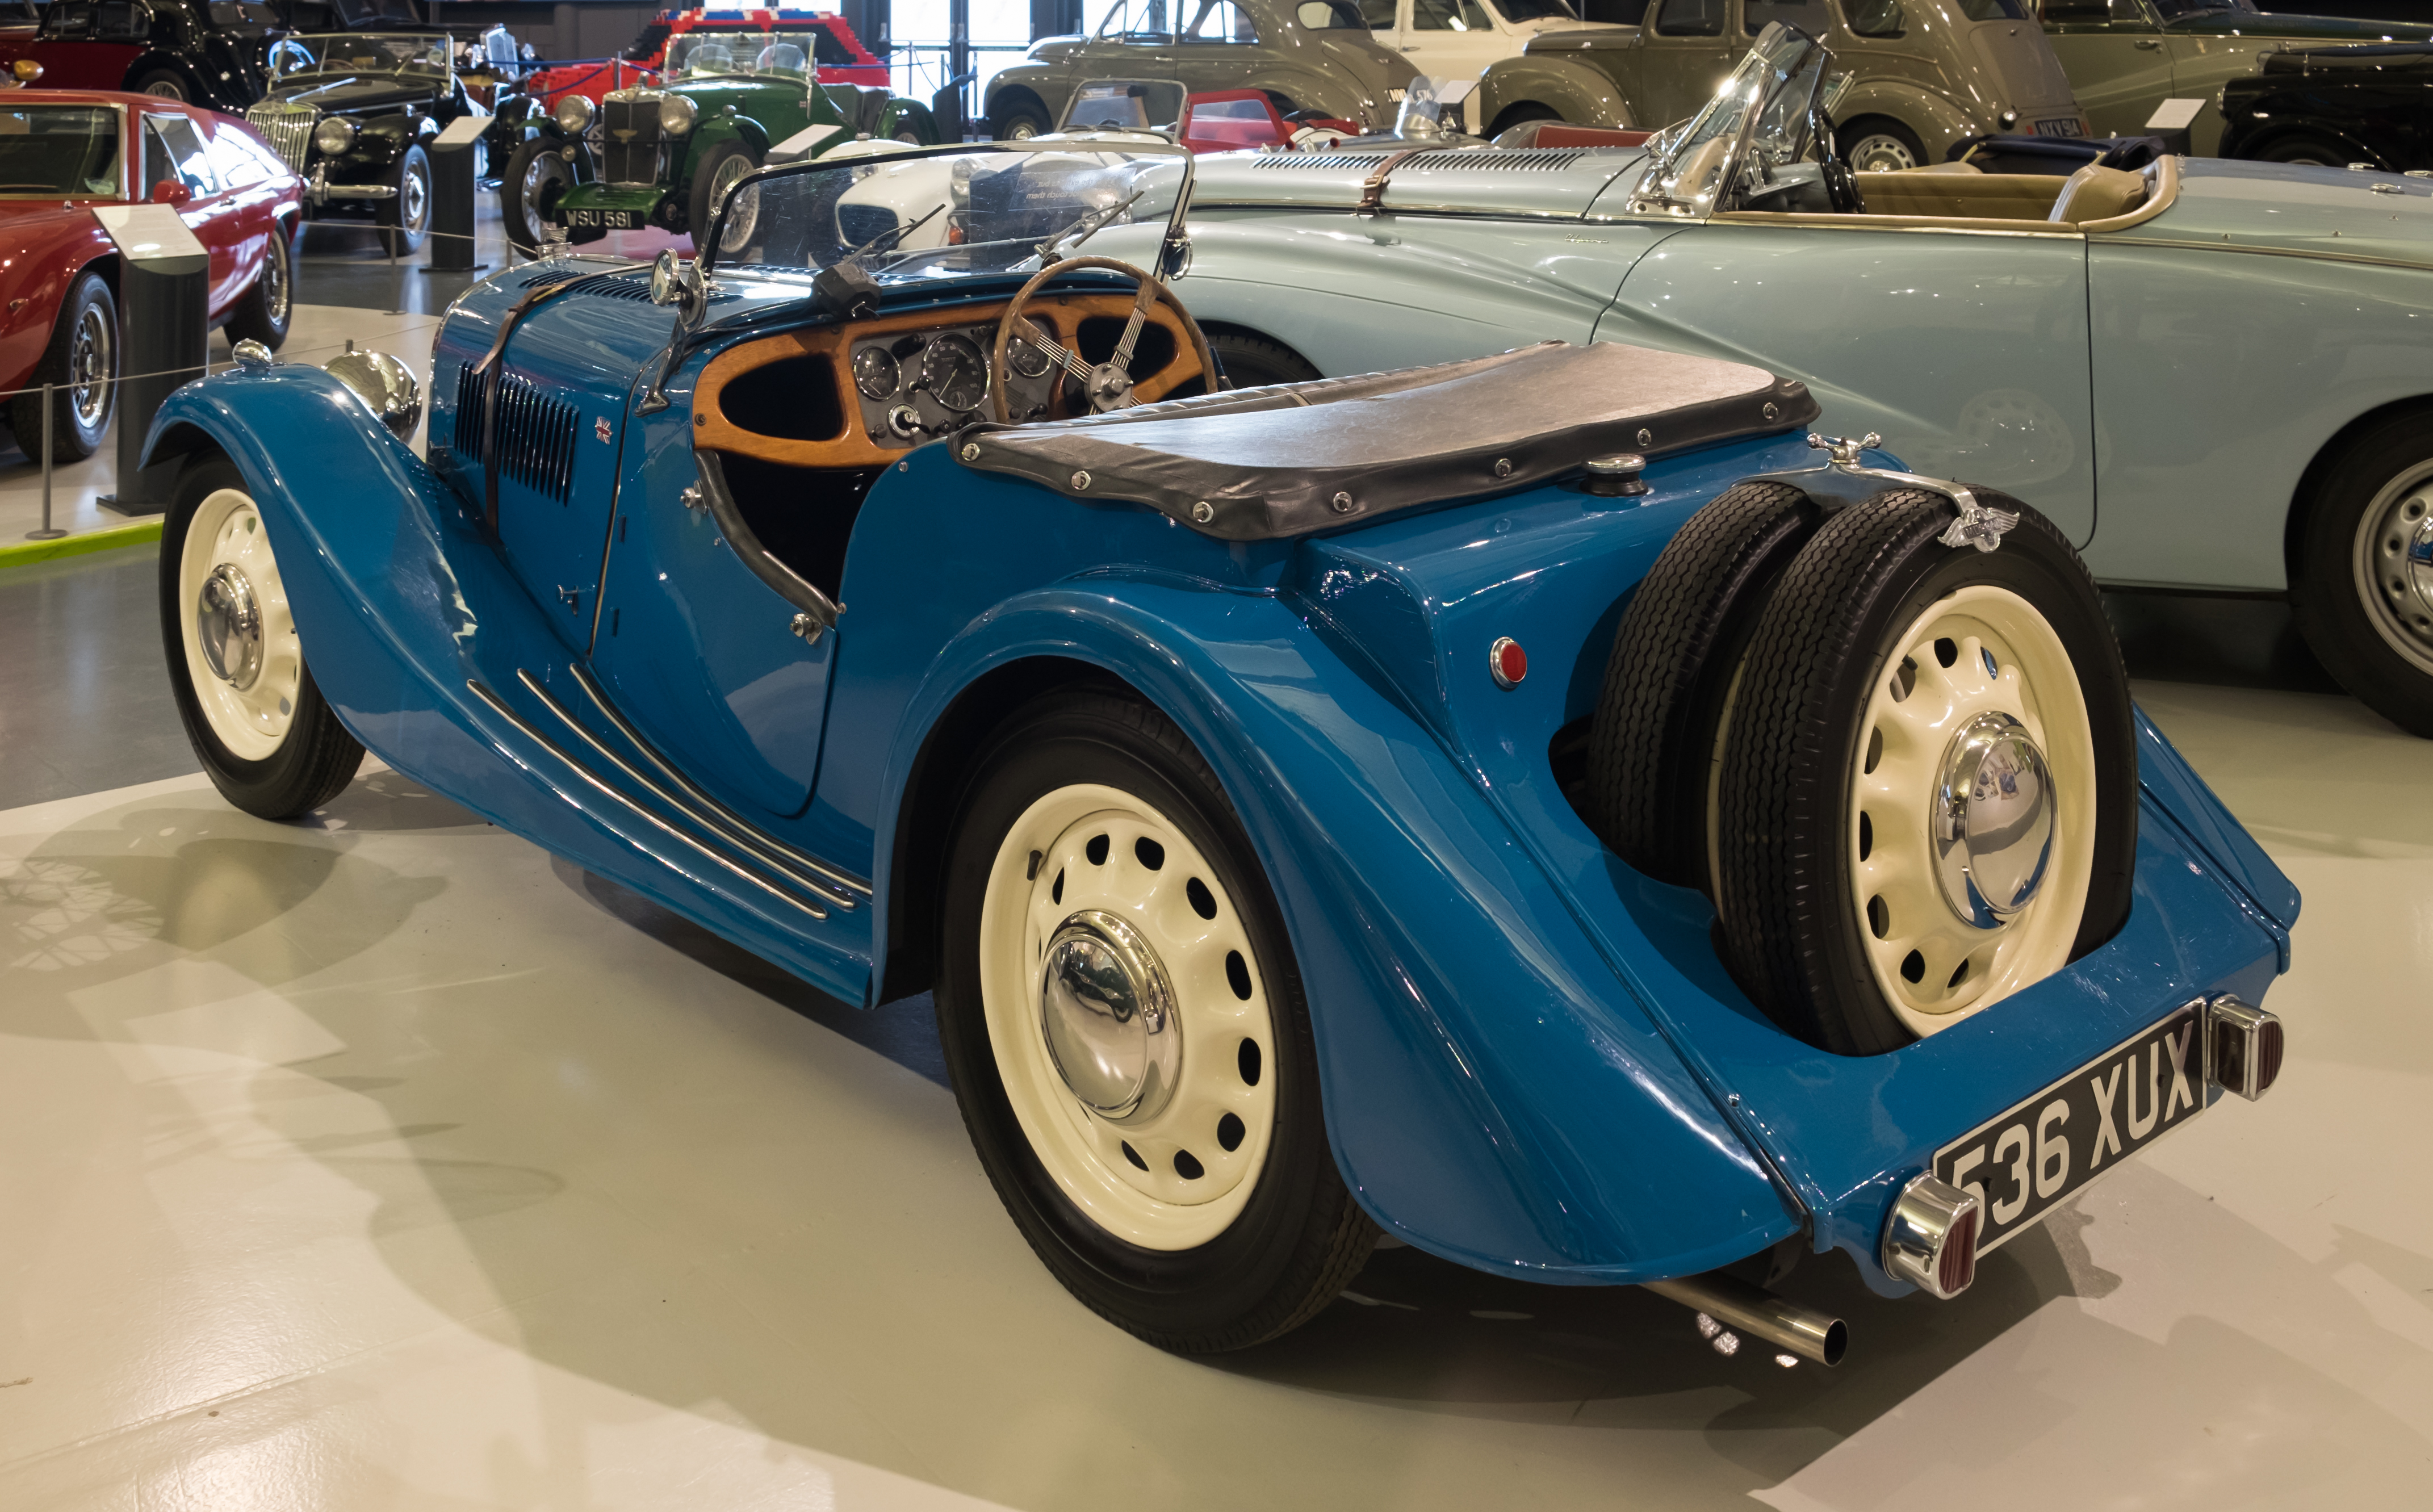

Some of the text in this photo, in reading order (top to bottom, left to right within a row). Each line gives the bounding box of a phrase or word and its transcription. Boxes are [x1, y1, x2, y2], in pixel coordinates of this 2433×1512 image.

[566, 210, 631, 227] WSU 581
[1952, 1020, 2194, 1241] 536 XUX
